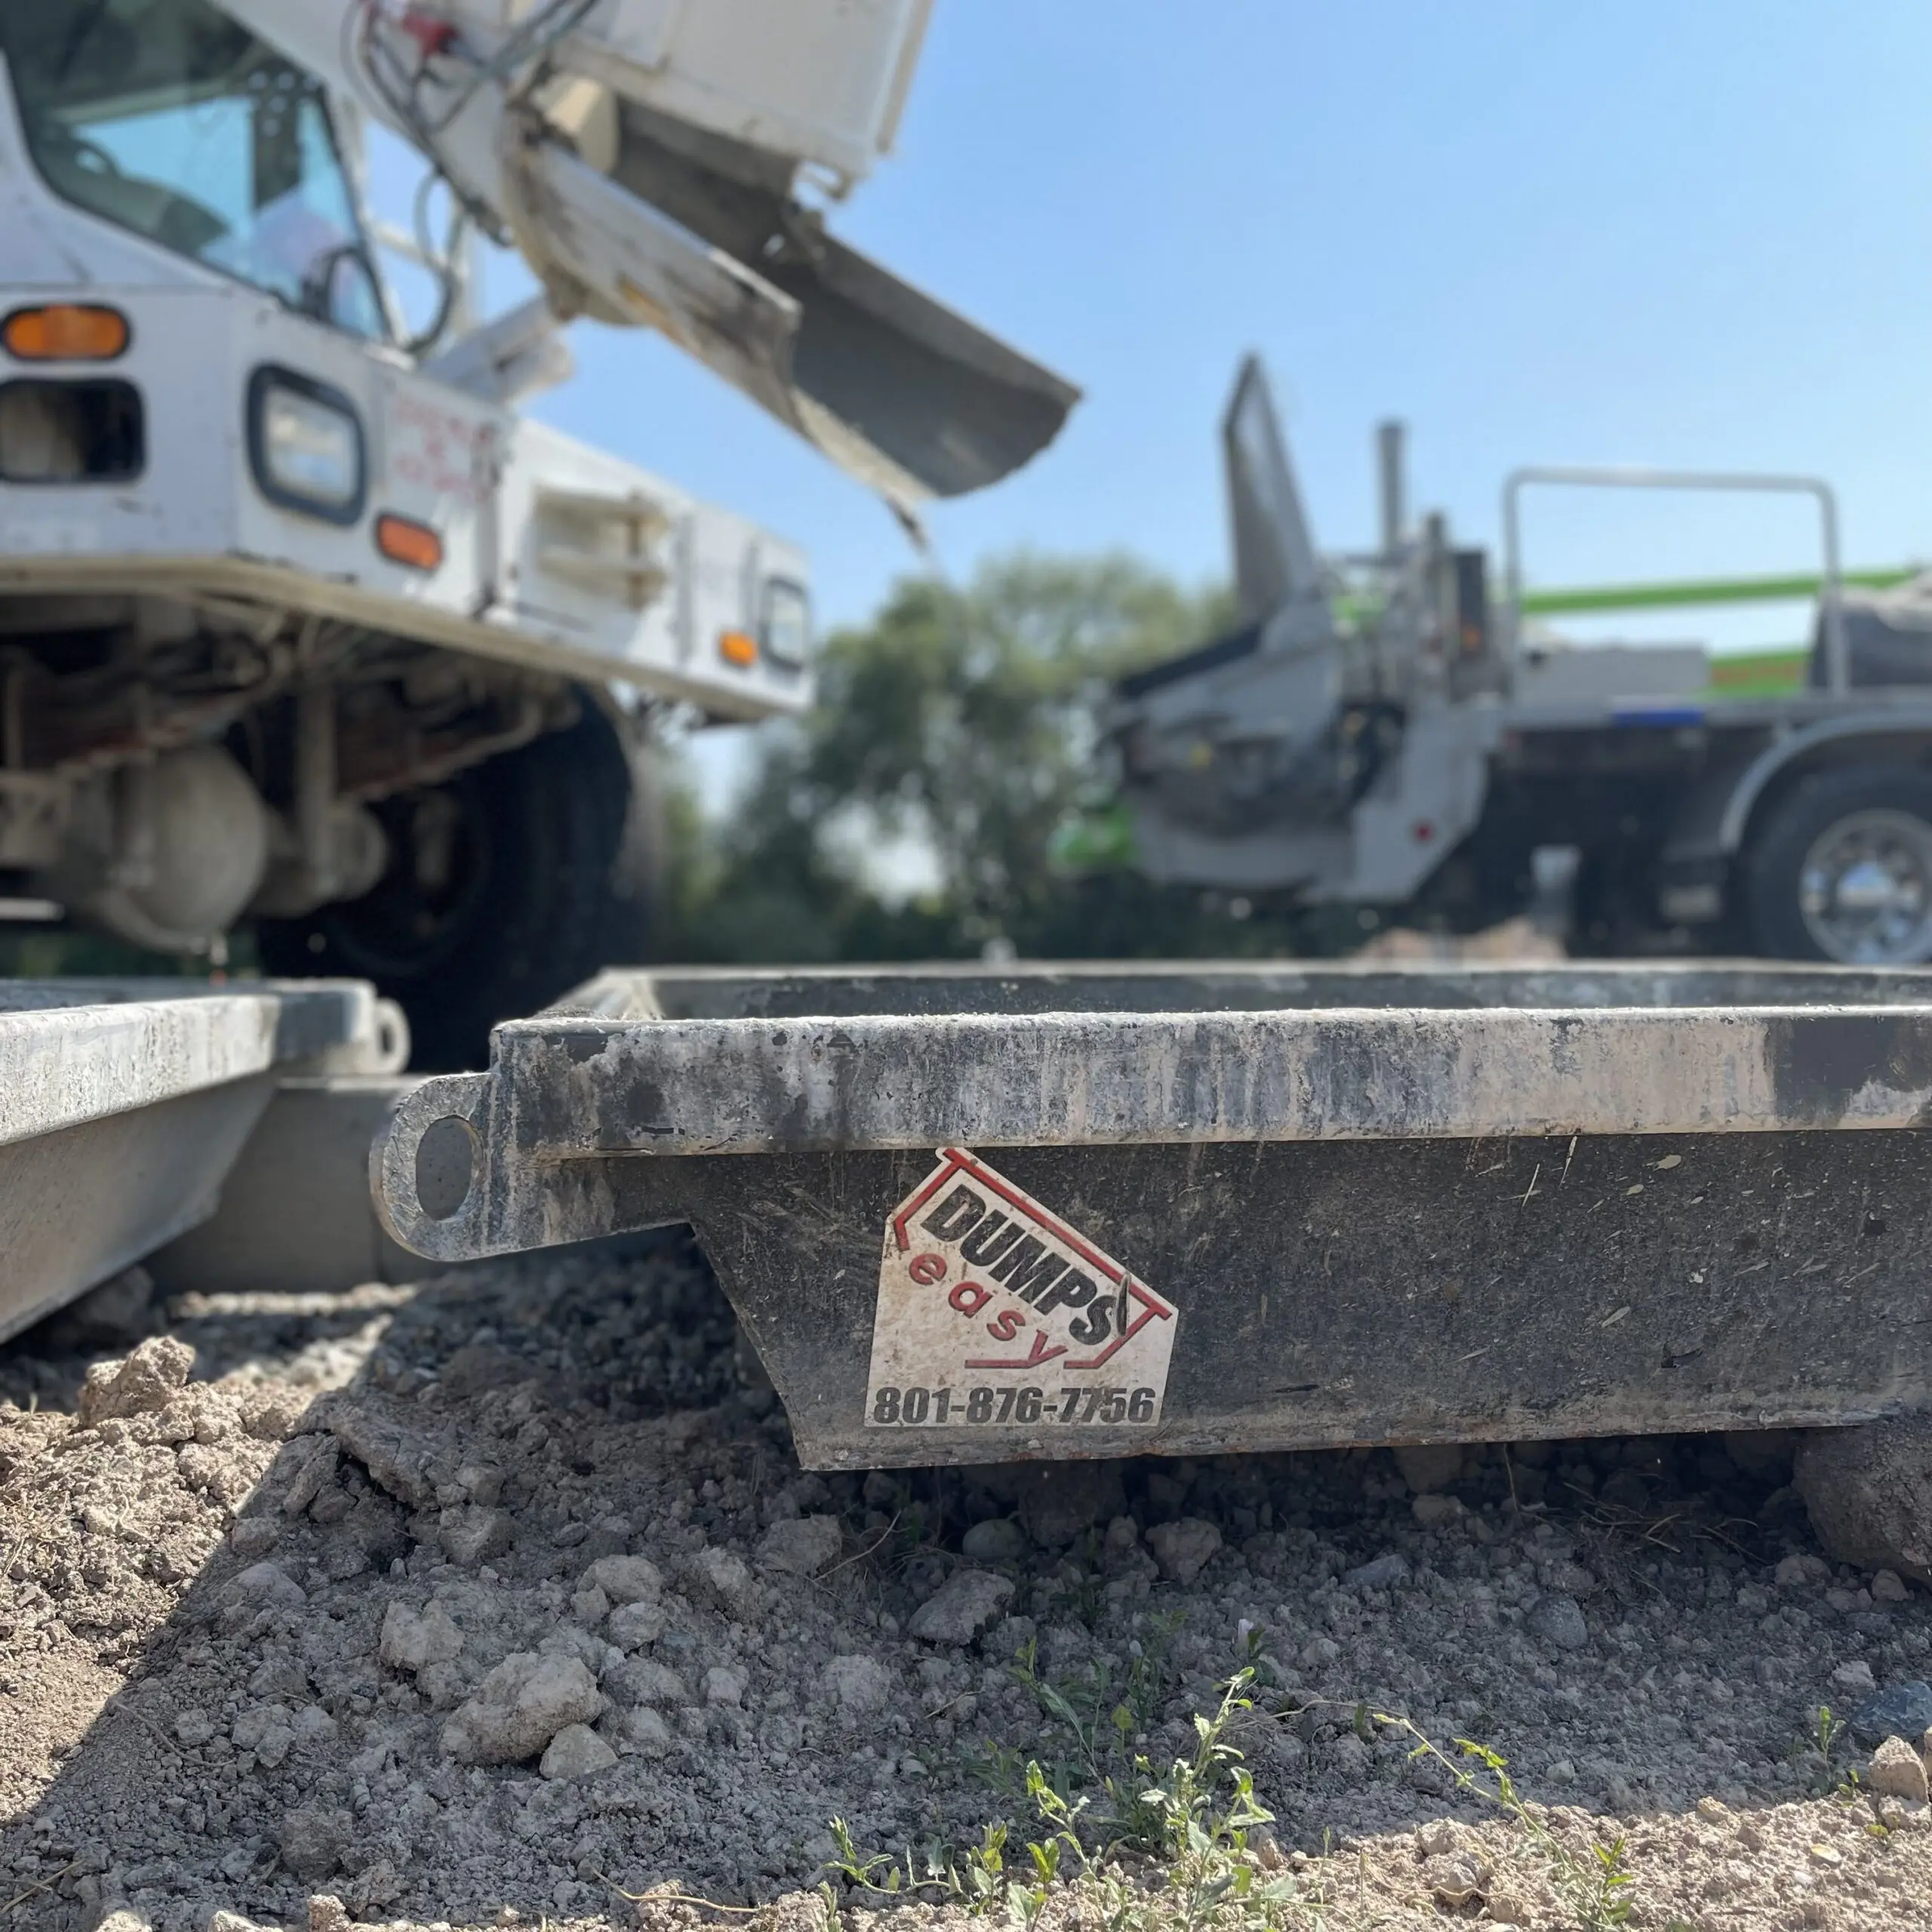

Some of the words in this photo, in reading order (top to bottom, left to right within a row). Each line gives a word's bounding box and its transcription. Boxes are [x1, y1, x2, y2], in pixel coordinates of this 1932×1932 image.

[908, 1252, 1069, 1369] easy
[921, 1183, 1118, 1346] DUMPS
[872, 1386, 1157, 1424] 801-876-7756
